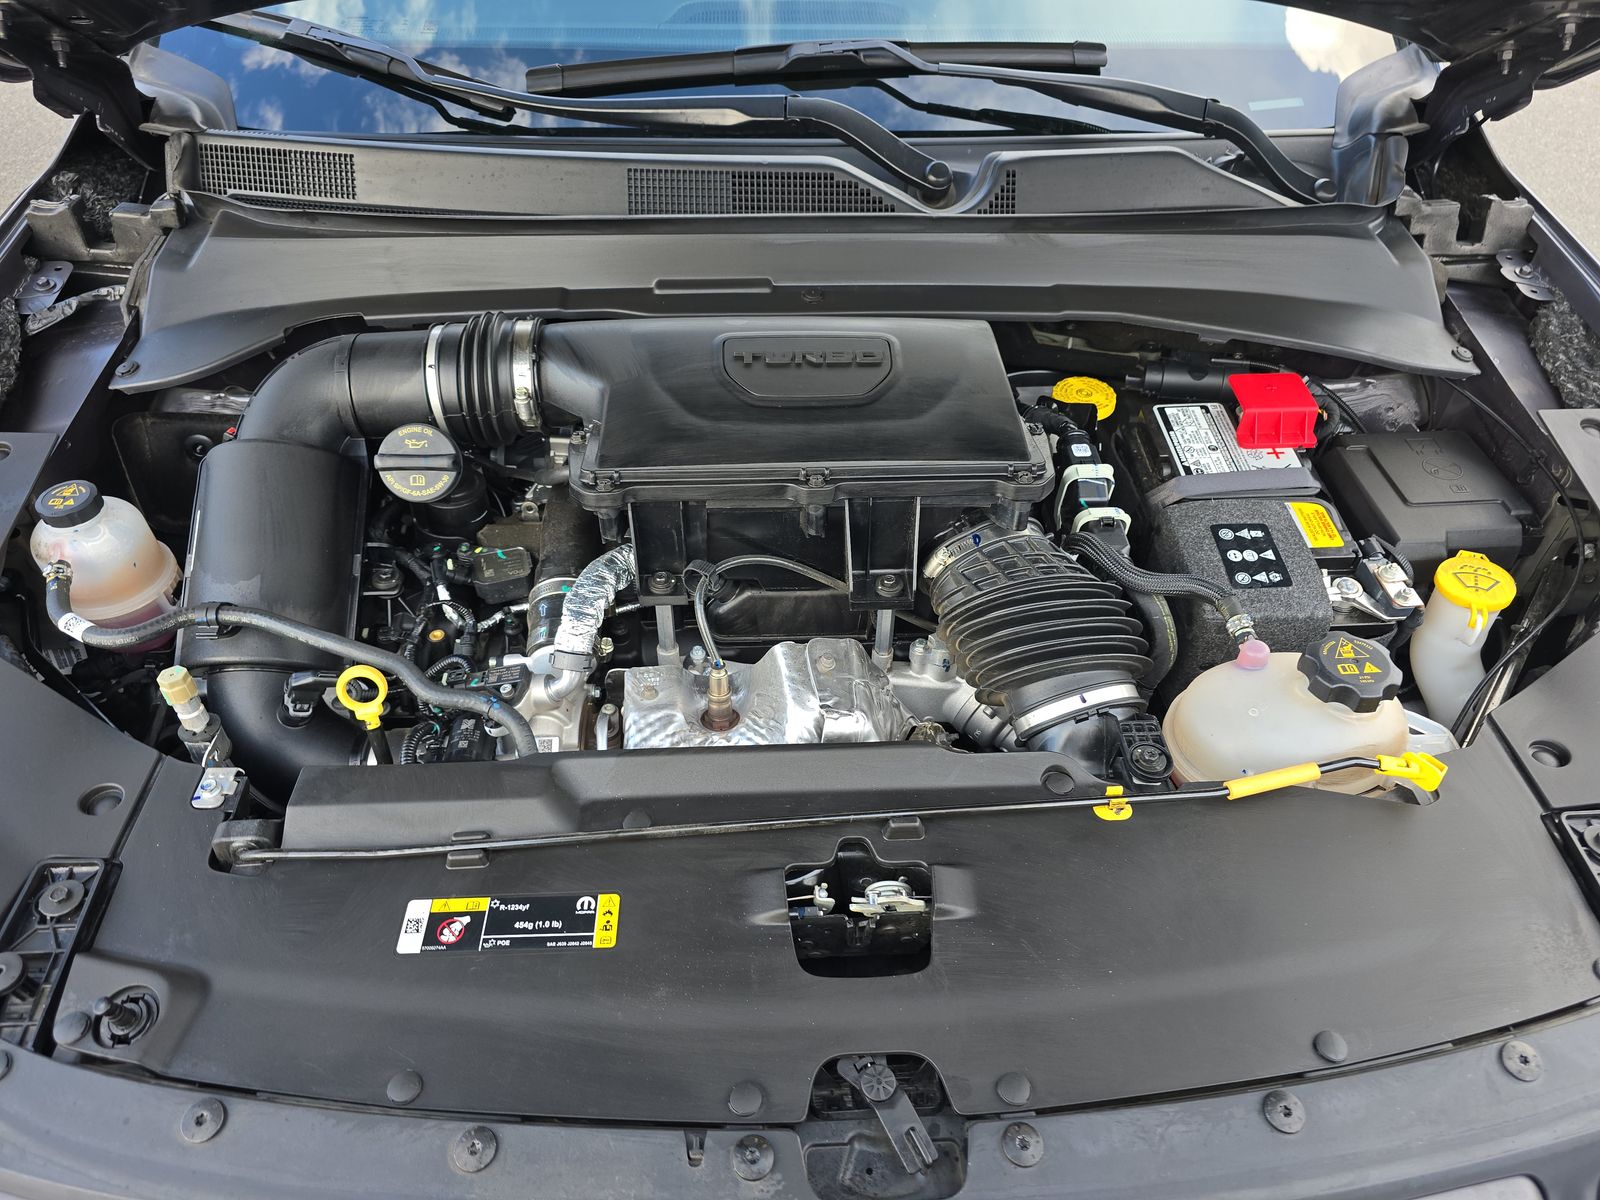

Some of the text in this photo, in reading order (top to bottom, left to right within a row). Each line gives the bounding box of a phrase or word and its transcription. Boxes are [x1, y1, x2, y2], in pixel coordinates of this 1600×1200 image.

[733, 351, 883, 367] TURBO
[398, 427, 433, 436] ENGINE OIL
[385, 474, 395, 485] API
[499, 903, 530, 912] R-1234yf
[514, 920, 562, 930] 454g (1.0 lb)
